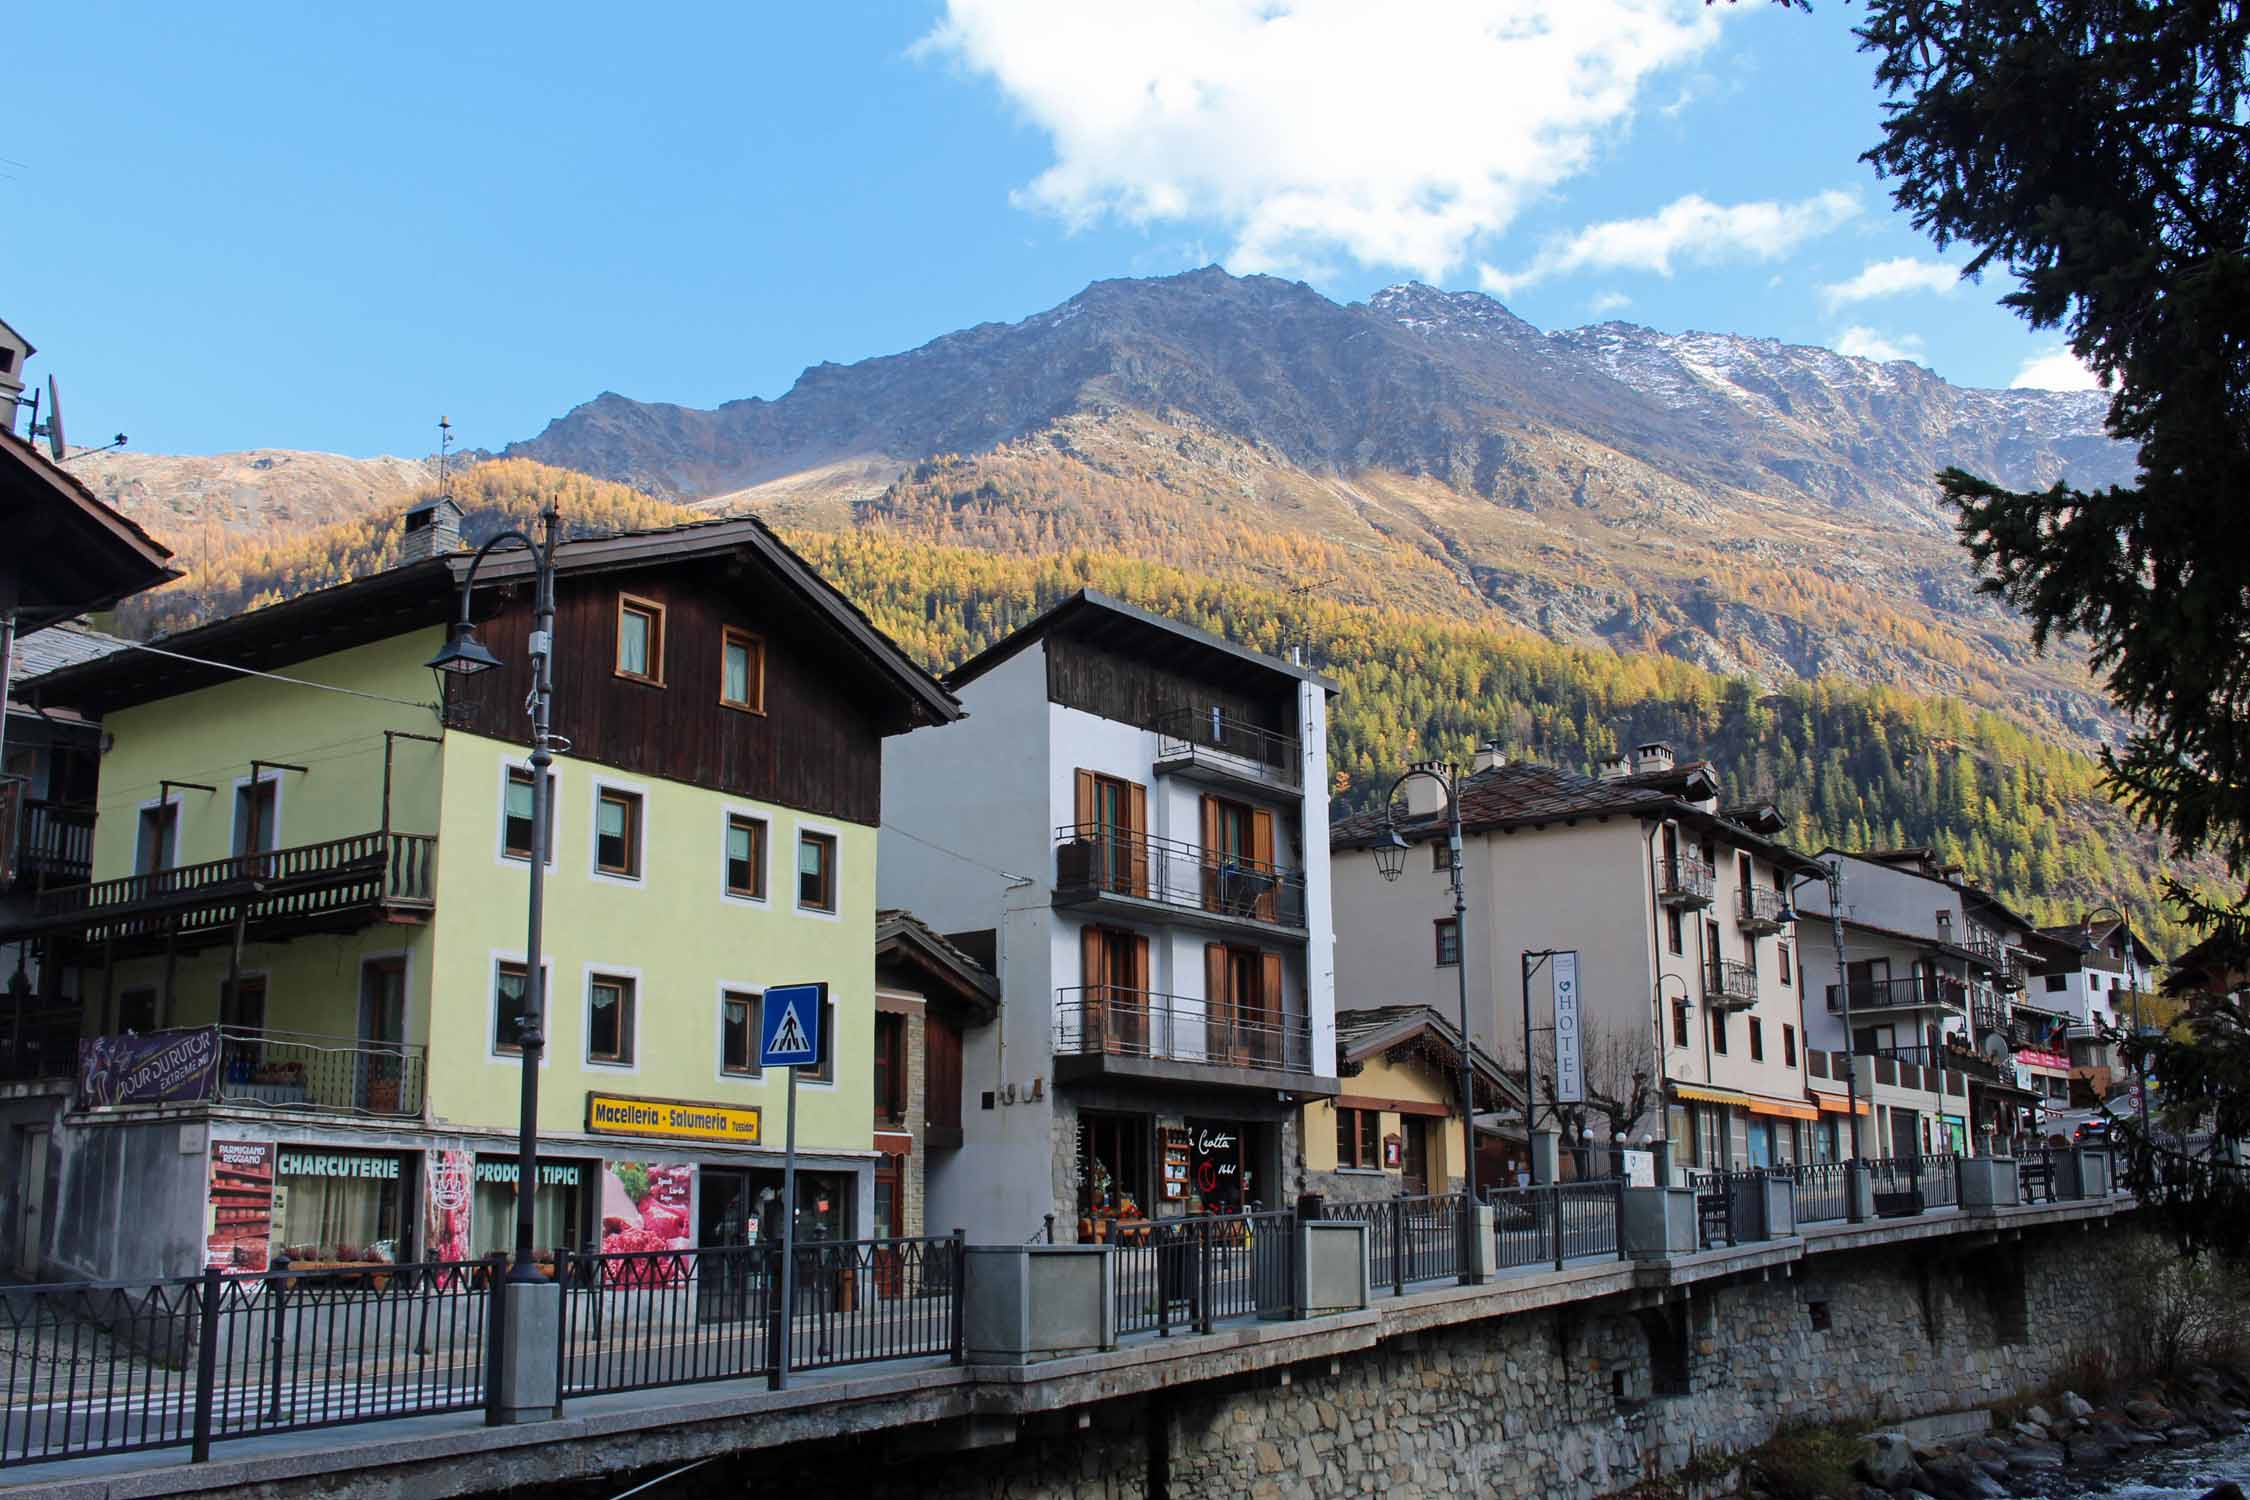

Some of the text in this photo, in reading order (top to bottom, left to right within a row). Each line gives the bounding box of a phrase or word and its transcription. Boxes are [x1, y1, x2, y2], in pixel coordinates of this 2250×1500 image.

[152, 1055, 170, 1080] DU
[169, 1032, 211, 1066] RUTOR
[1559, 995, 1575, 1094] HOTEL
[596, 1103, 659, 1126] Macelleria
[669, 1109, 728, 1131] Salumeria
[219, 1144, 265, 1156] PARMIGIANO
[1198, 1128, 1237, 1155] Crotta
[223, 1154, 261, 1164] REGGIANO
[278, 1153, 400, 1179] CHARCUTERIE
[476, 1163, 579, 1185] PRODOI TIPICI
